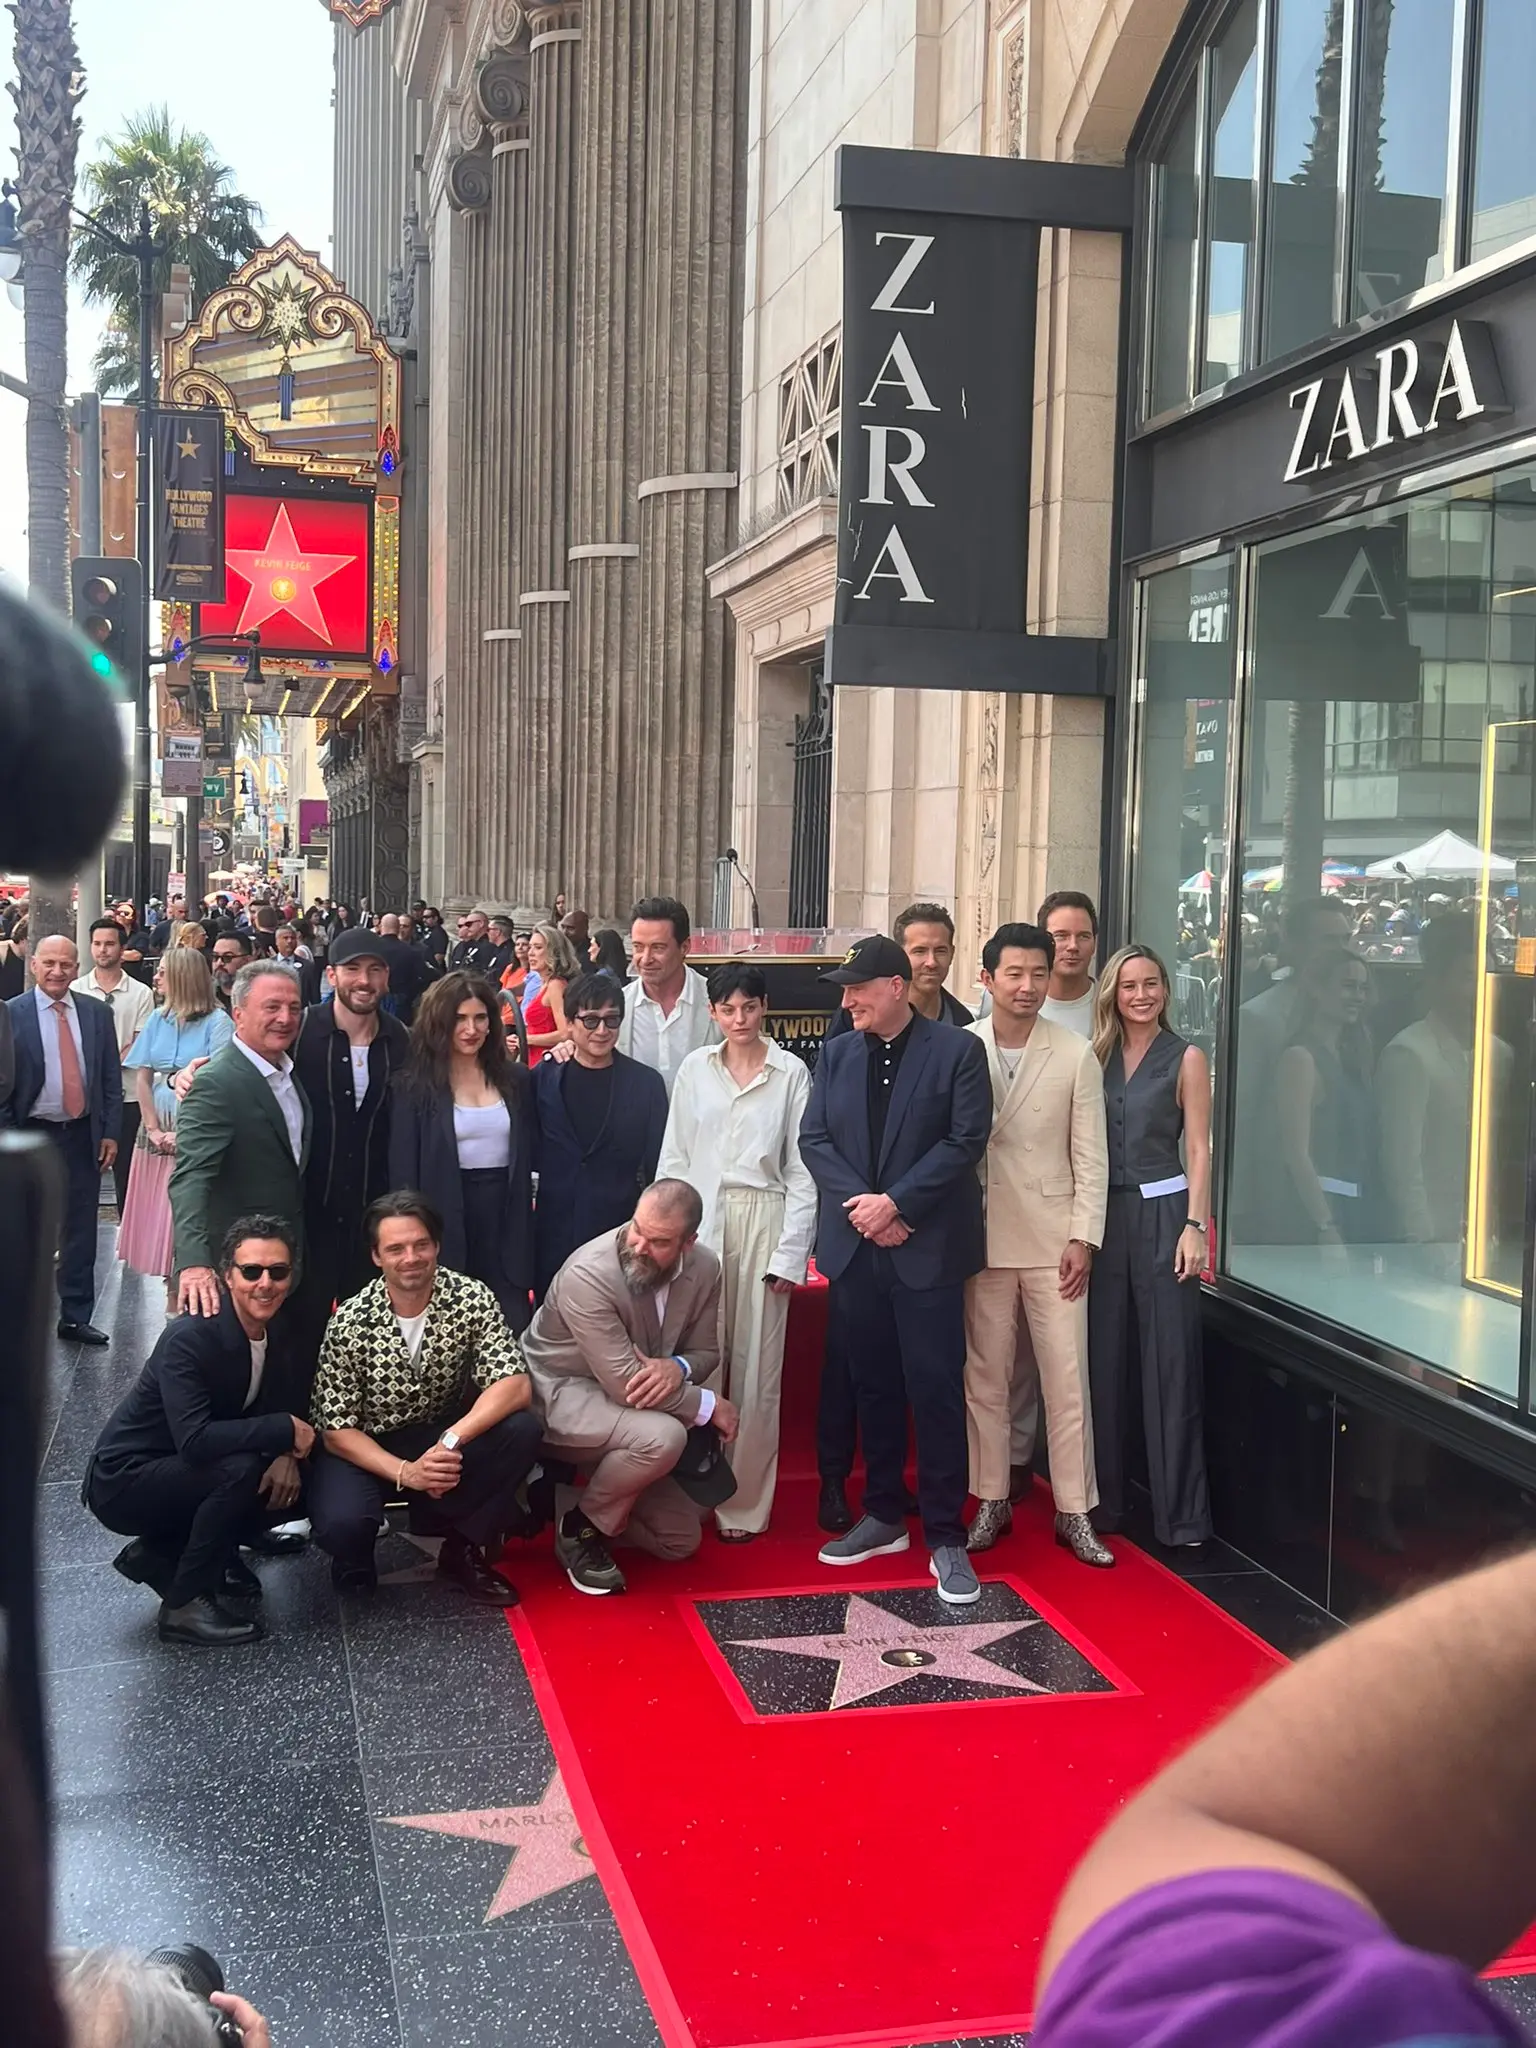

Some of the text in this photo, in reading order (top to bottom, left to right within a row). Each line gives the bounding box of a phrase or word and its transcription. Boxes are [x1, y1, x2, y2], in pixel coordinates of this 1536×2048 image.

[1283, 319, 1485, 482] ZARA
[854, 232, 941, 603] ZARA
[165, 488, 213, 502] HOLLYWOOD
[169, 502, 209, 515] PANTAGES
[172, 516, 206, 528] THEATRE
[254, 558, 312, 571] KEVIN FEIGE
[203, 782, 220, 794] wy
[777, 1041, 793, 1049] OF
[823, 1632, 955, 1650] KEVIN FEIGE
[479, 1812, 574, 1829] MARLO
